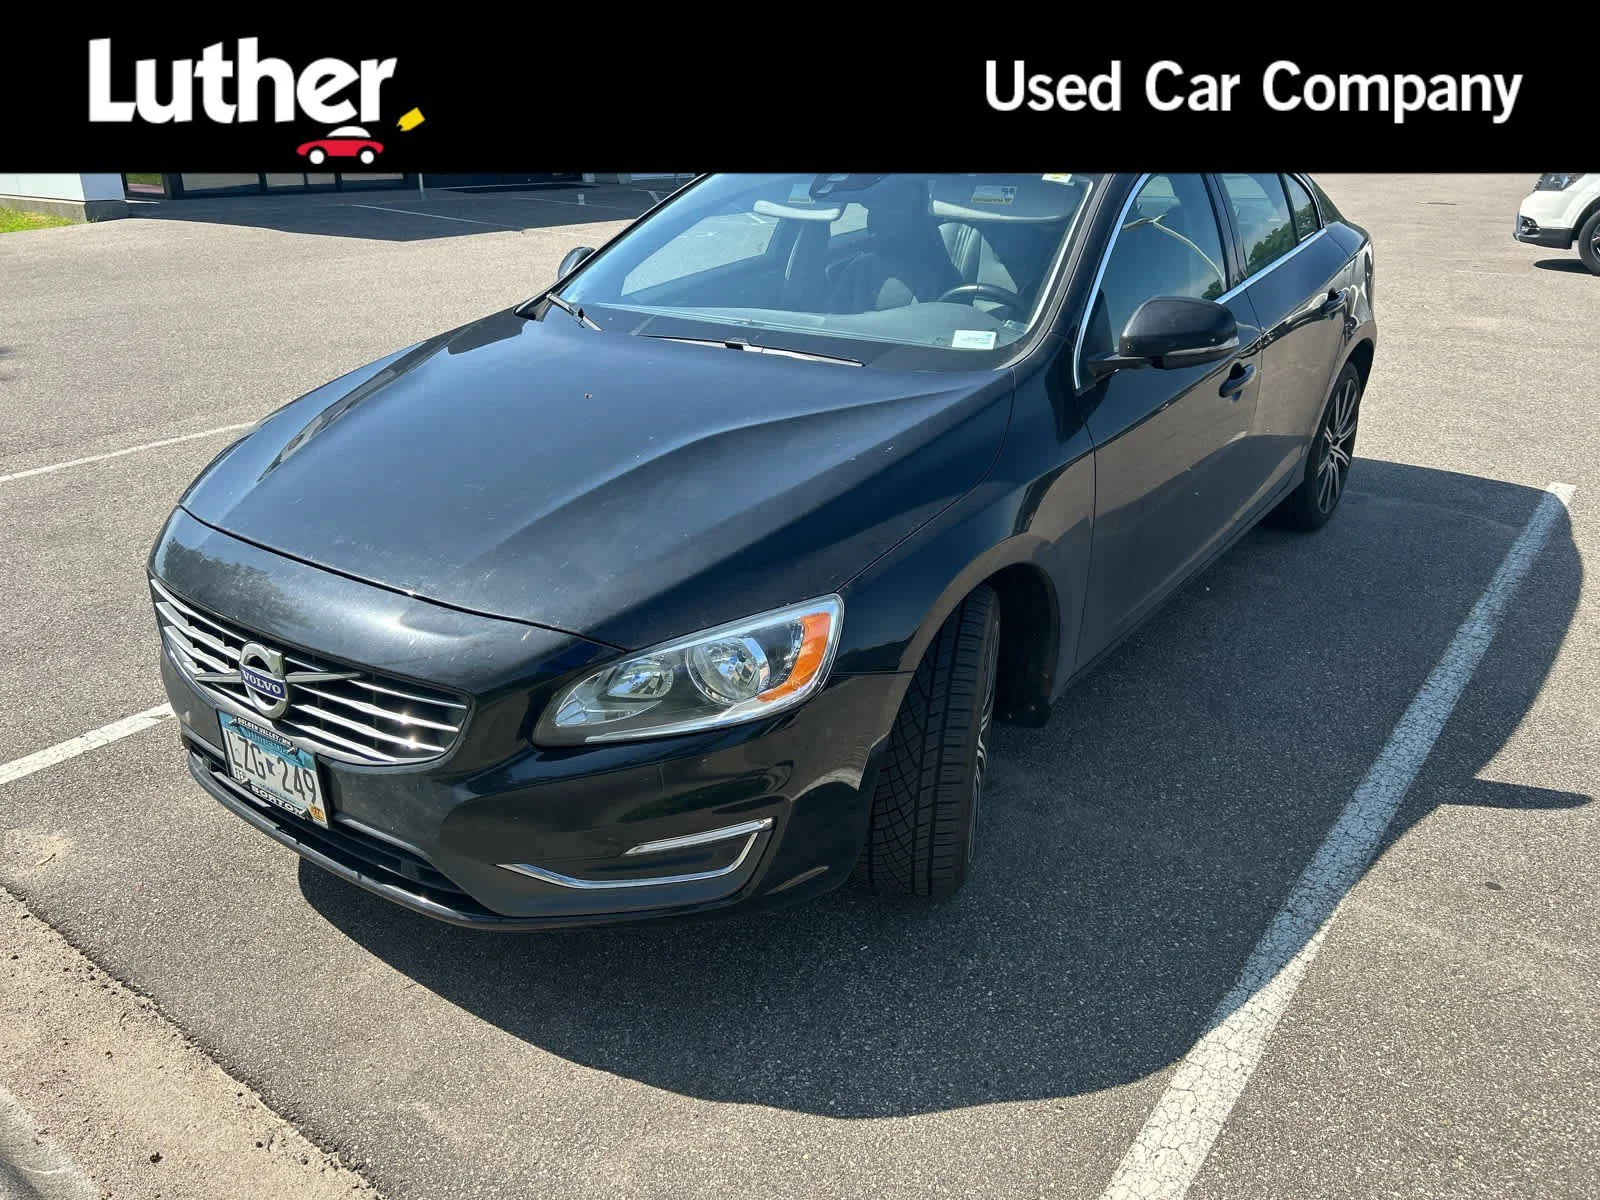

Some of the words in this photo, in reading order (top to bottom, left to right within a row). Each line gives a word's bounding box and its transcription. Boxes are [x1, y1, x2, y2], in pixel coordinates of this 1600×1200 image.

[242, 670, 282, 694] VOLVO
[226, 729, 267, 781] LZG
[277, 757, 317, 805] 249
